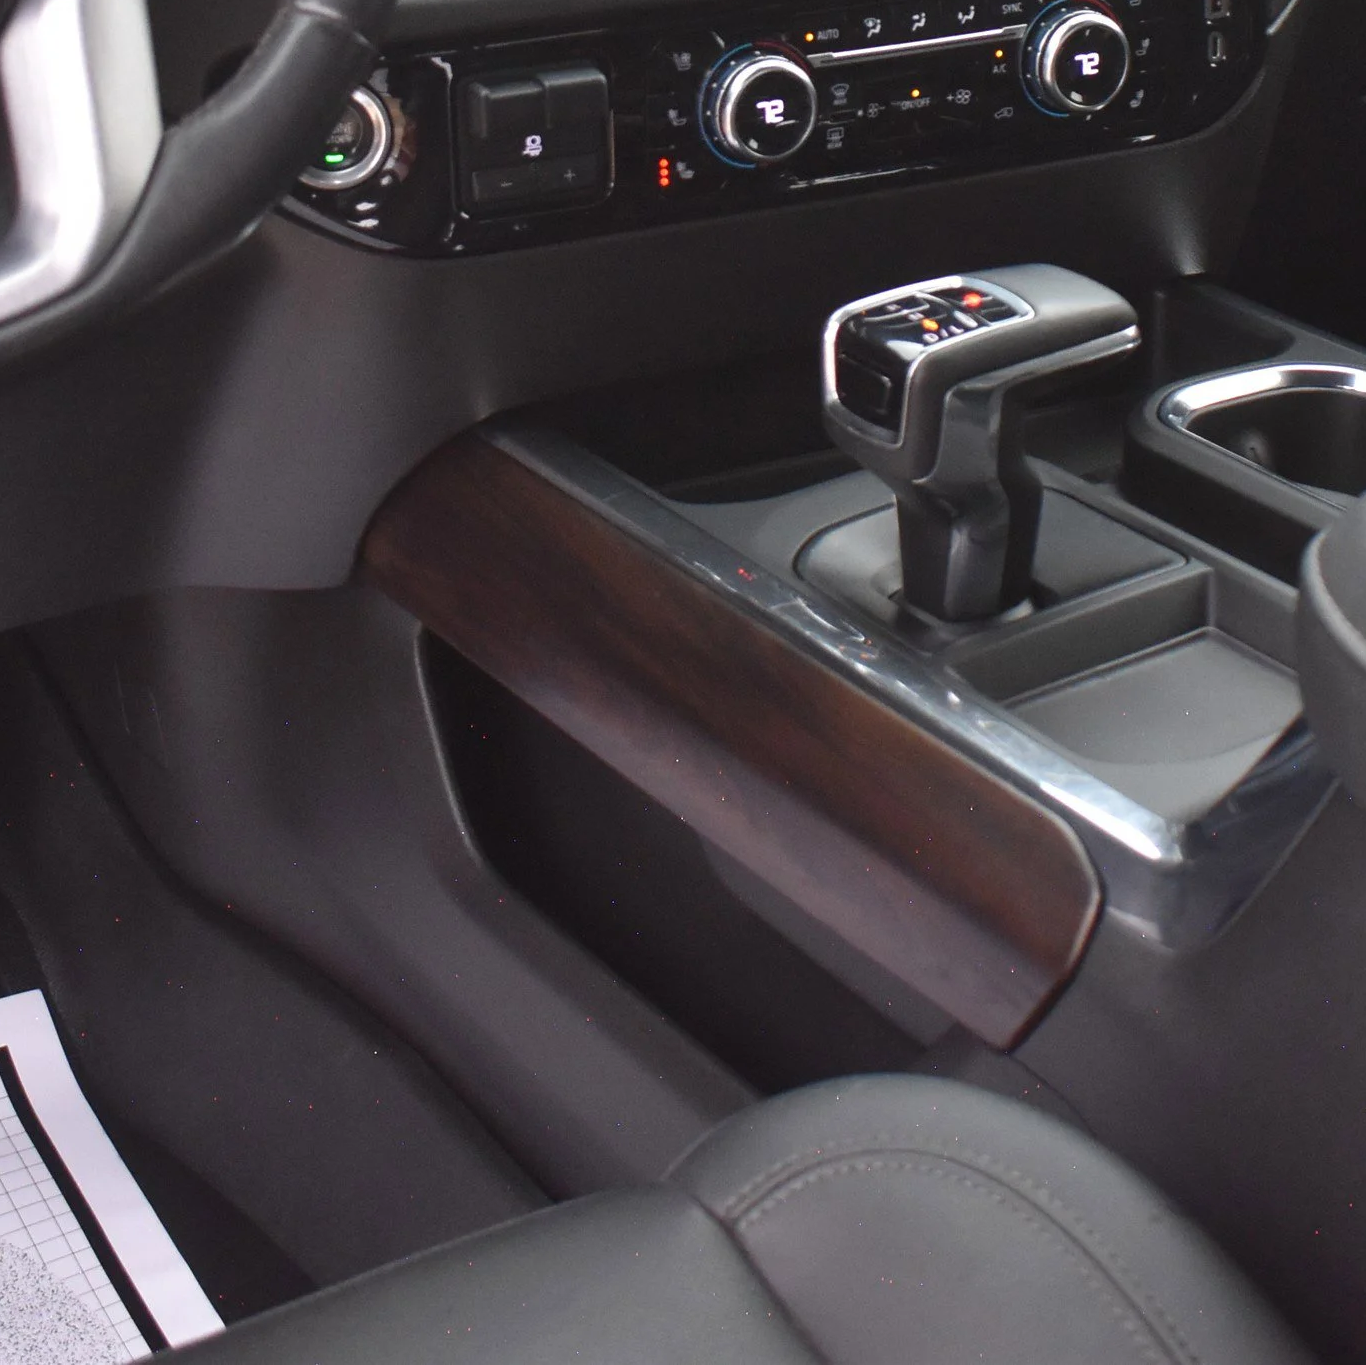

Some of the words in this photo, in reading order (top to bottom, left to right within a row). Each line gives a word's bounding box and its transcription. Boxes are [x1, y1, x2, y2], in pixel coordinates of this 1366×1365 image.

[1002, 3, 1022, 14] SYNC
[817, 28, 839, 40] AUTO
[993, 64, 1006, 74] A/C
[1075, 52, 1100, 75] 72
